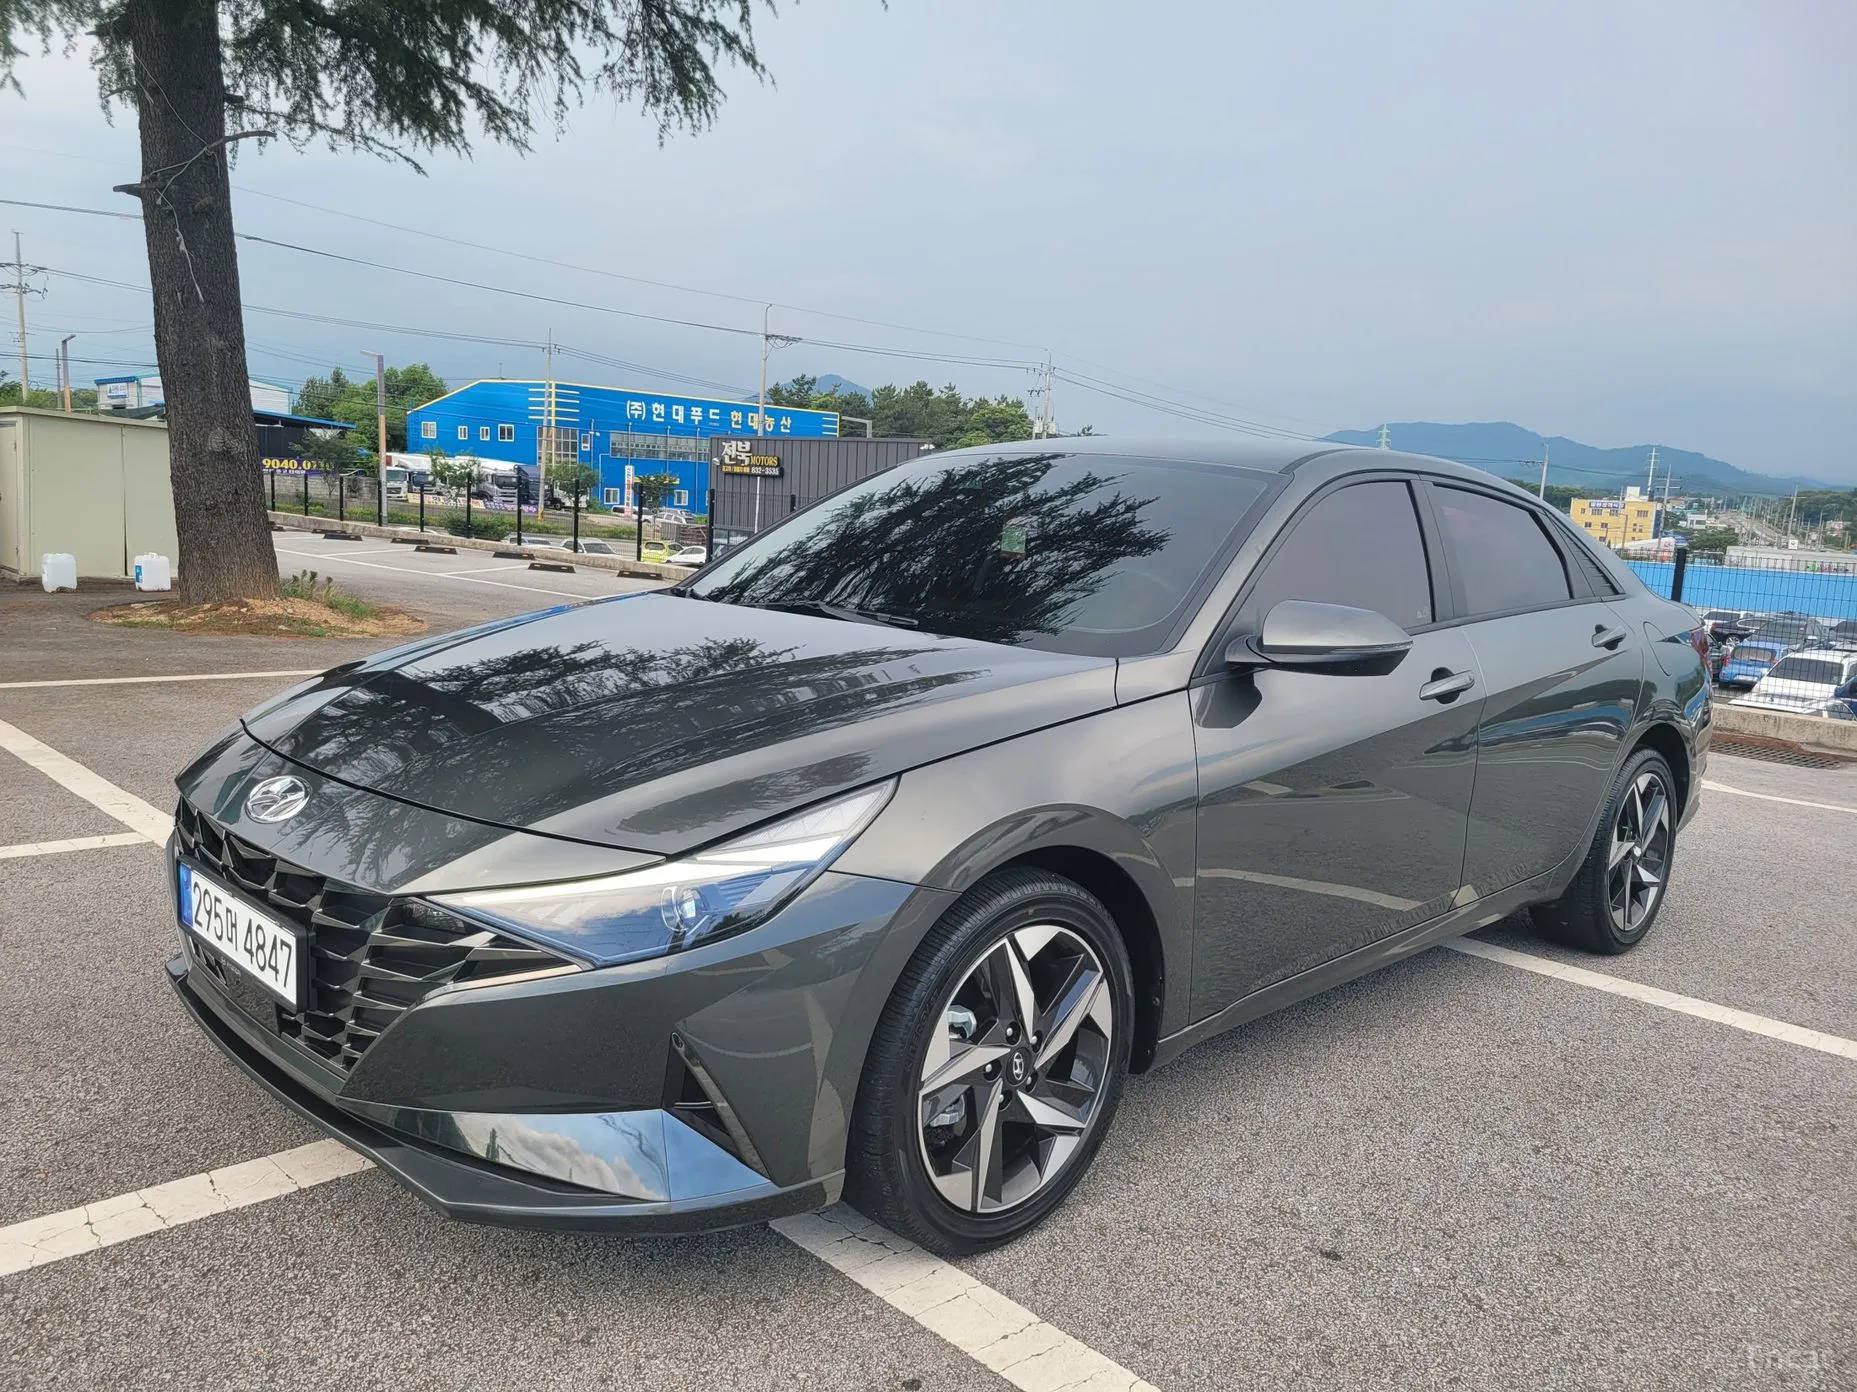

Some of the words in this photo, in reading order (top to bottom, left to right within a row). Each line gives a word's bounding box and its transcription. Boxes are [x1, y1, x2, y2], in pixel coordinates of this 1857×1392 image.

[721, 440, 753, 466] 전북
[750, 455, 778, 467] MOTORS
[193, 881, 238, 952] 295머
[243, 918, 292, 988] 4847
